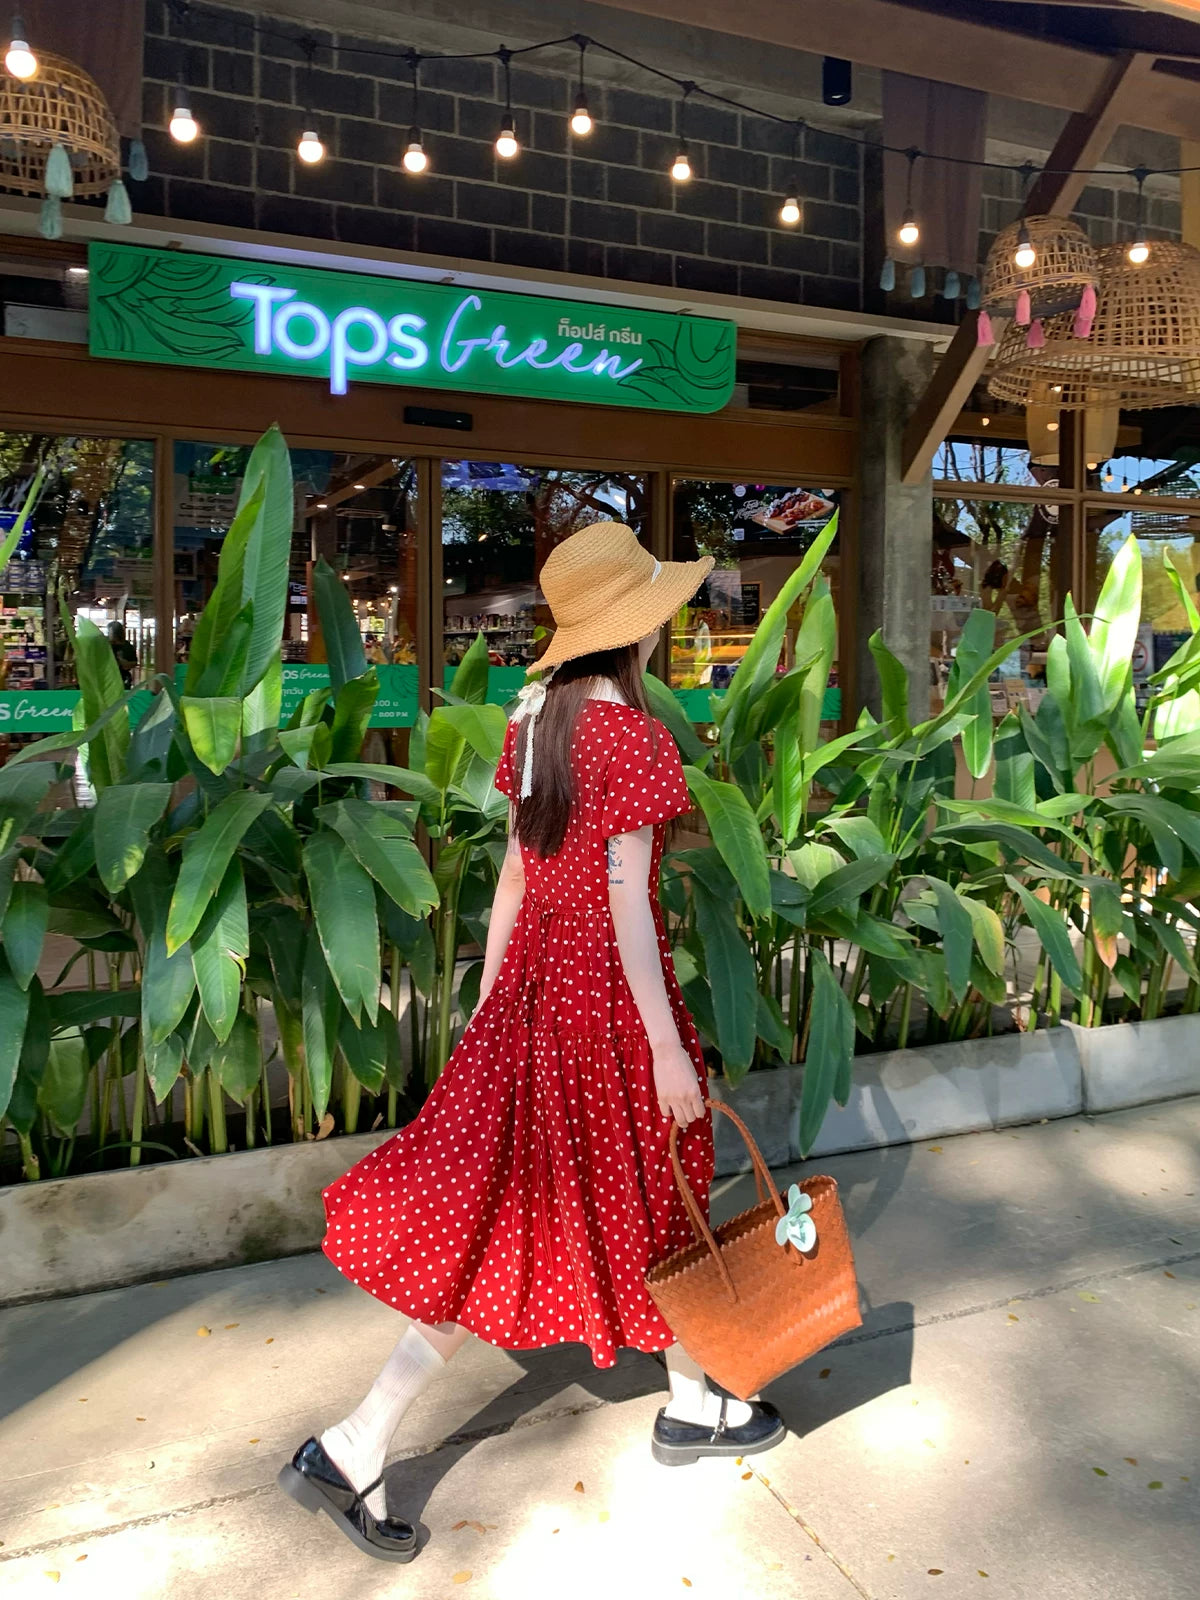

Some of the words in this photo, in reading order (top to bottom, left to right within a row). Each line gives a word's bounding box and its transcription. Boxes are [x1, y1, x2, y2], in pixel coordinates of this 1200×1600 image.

[230, 281, 429, 395] Tops
[439, 294, 643, 379] Green
[557, 317, 606, 341] ท็อปส์
[609, 326, 642, 345] กรีน
